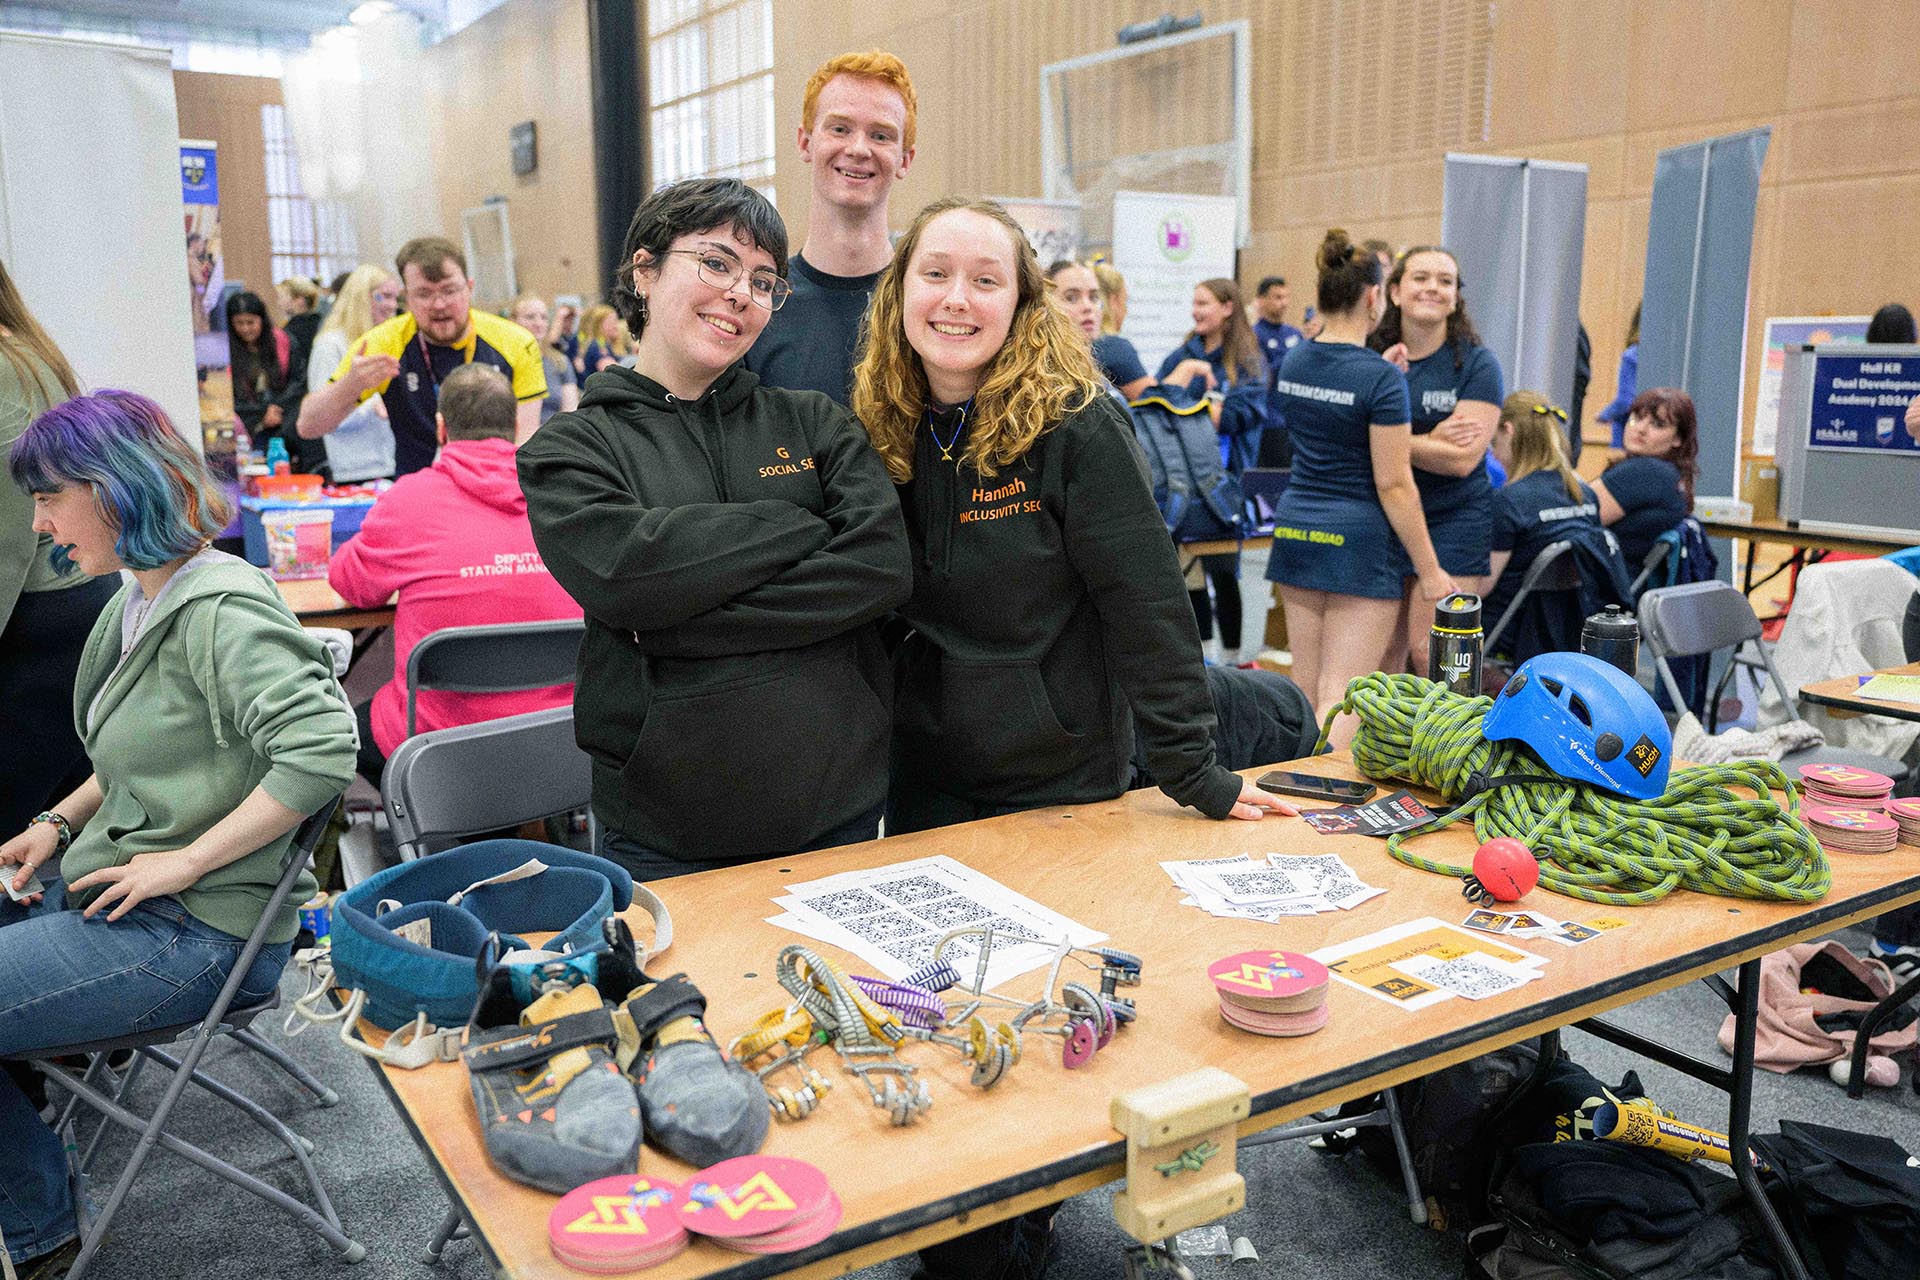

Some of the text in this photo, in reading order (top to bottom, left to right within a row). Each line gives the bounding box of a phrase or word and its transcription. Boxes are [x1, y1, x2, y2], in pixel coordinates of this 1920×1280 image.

[1884, 362, 1902, 374] KR
[1832, 377, 1857, 389] Dual
[776, 447, 790, 459] G
[758, 463, 801, 478] SOCIAL
[972, 477, 1026, 502] Hannah
[960, 502, 1021, 524] INCLUSIVITY
[1309, 530, 1345, 547] SQUAD
[494, 552, 541, 565] DEPUTY
[460, 565, 513, 578] STATION
[1577, 748, 1622, 789] Black Diamond
[1657, 1120, 1700, 1142] Welcome
